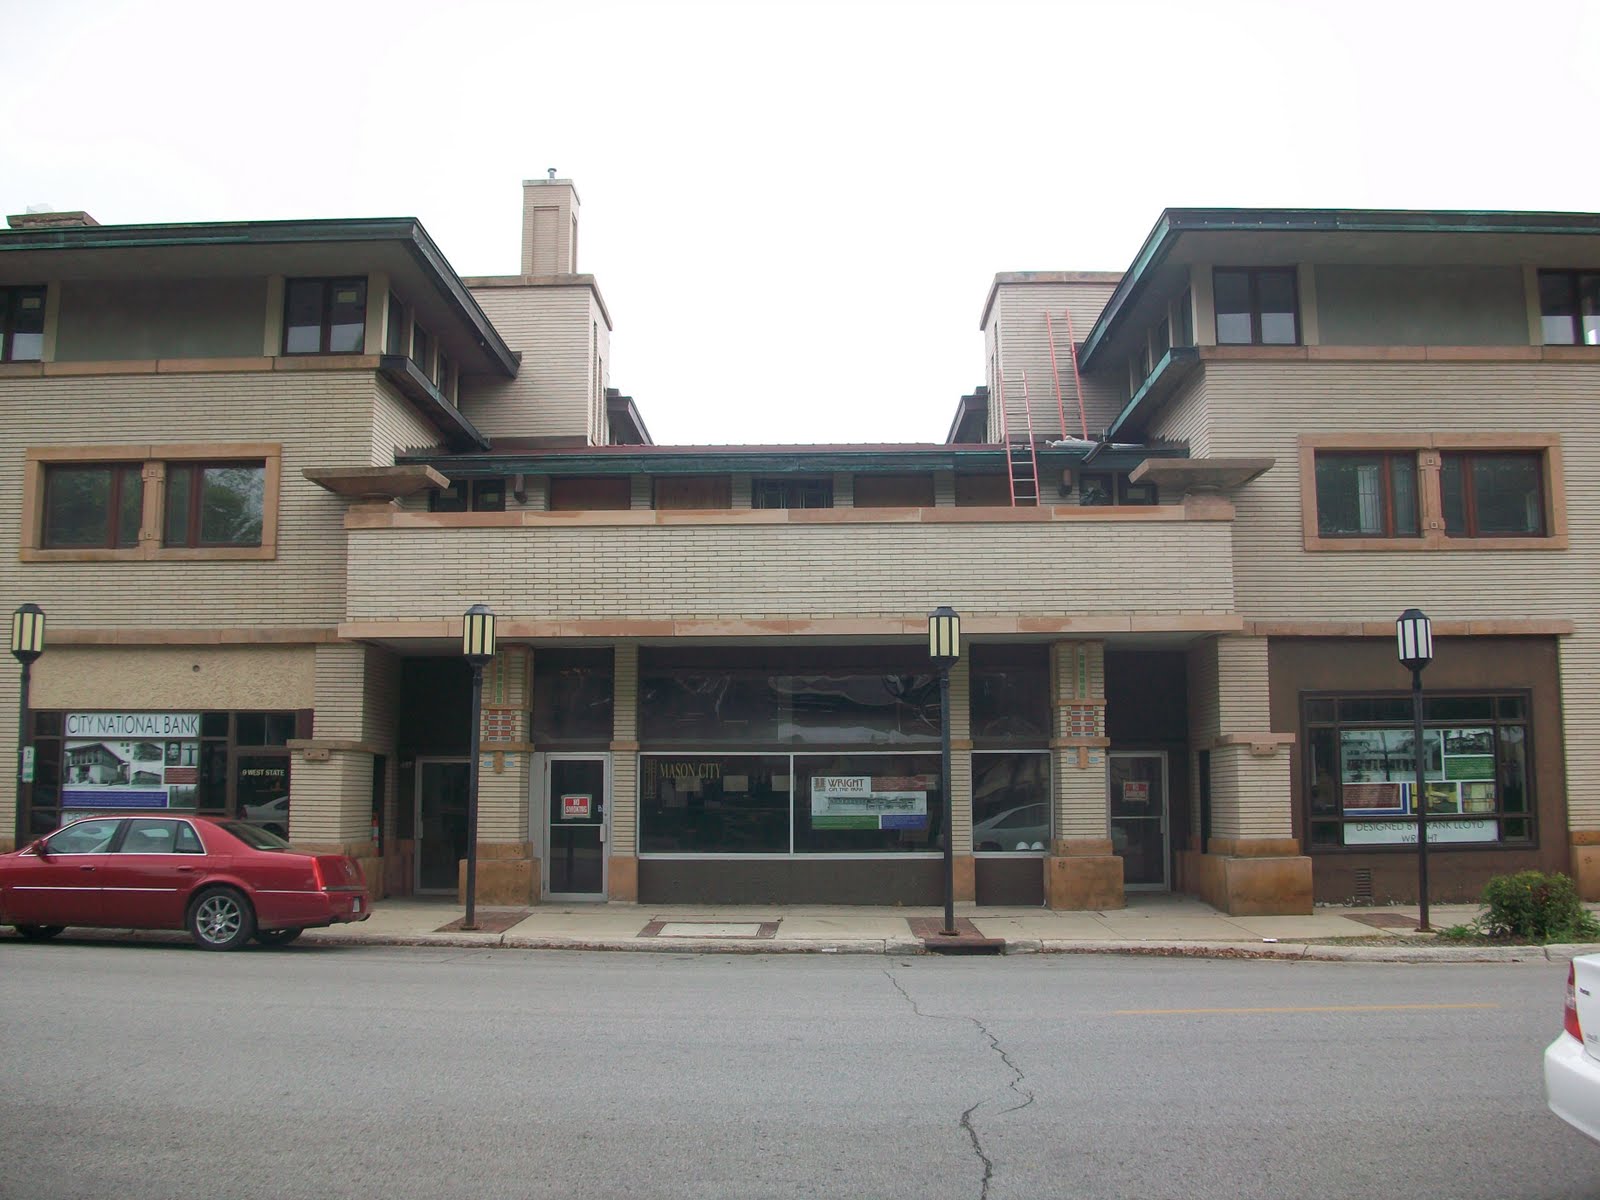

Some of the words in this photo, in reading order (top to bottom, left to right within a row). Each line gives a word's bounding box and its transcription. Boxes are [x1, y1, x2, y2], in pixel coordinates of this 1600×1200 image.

[67, 714, 95, 734] CITY
[97, 714, 160, 735] NATIONAL
[163, 714, 199, 735] BANK
[660, 762, 697, 779] MASON
[698, 762, 721, 780] CITY
[827, 778, 865, 788] WRIGHT
[1356, 822, 1404, 832] DESIGNED
[1426, 821, 1451, 830] RANK
[1454, 820, 1485, 830] LLOYD
[1401, 833, 1438, 843] WRHT
